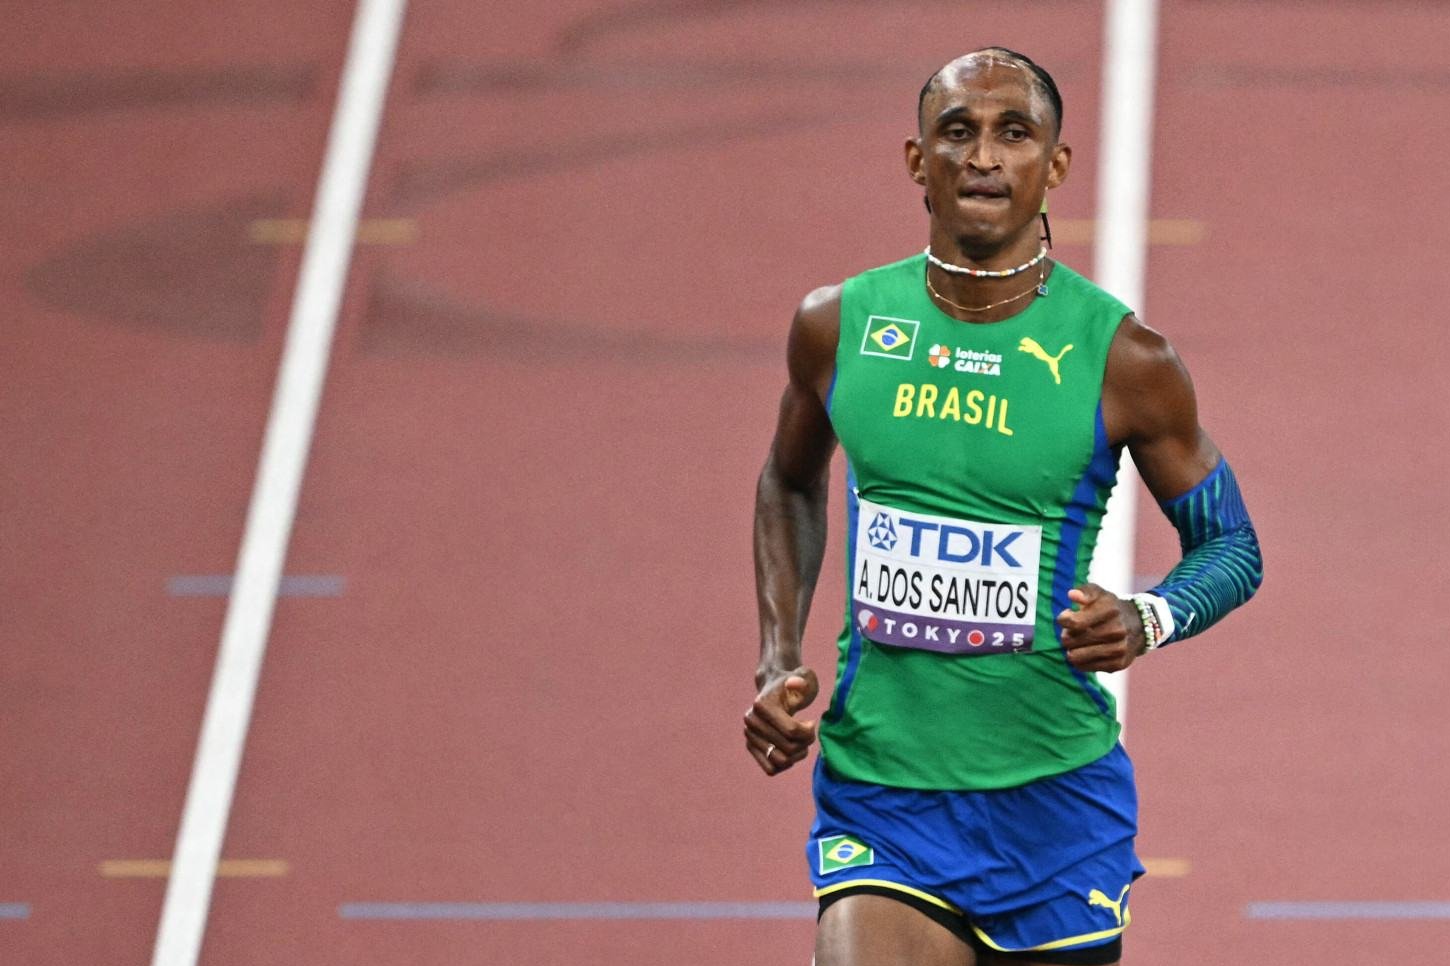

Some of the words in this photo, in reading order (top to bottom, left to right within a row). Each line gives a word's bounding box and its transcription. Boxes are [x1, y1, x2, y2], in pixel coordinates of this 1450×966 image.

[954, 359, 1001, 376] CAIXA
[955, 347, 1002, 363] loterias
[893, 384, 1014, 436] BRASIL
[899, 517, 1024, 568] TDK
[859, 560, 873, 599] A.
[878, 565, 922, 610] DOS
[929, 574, 1029, 618] SANTOS
